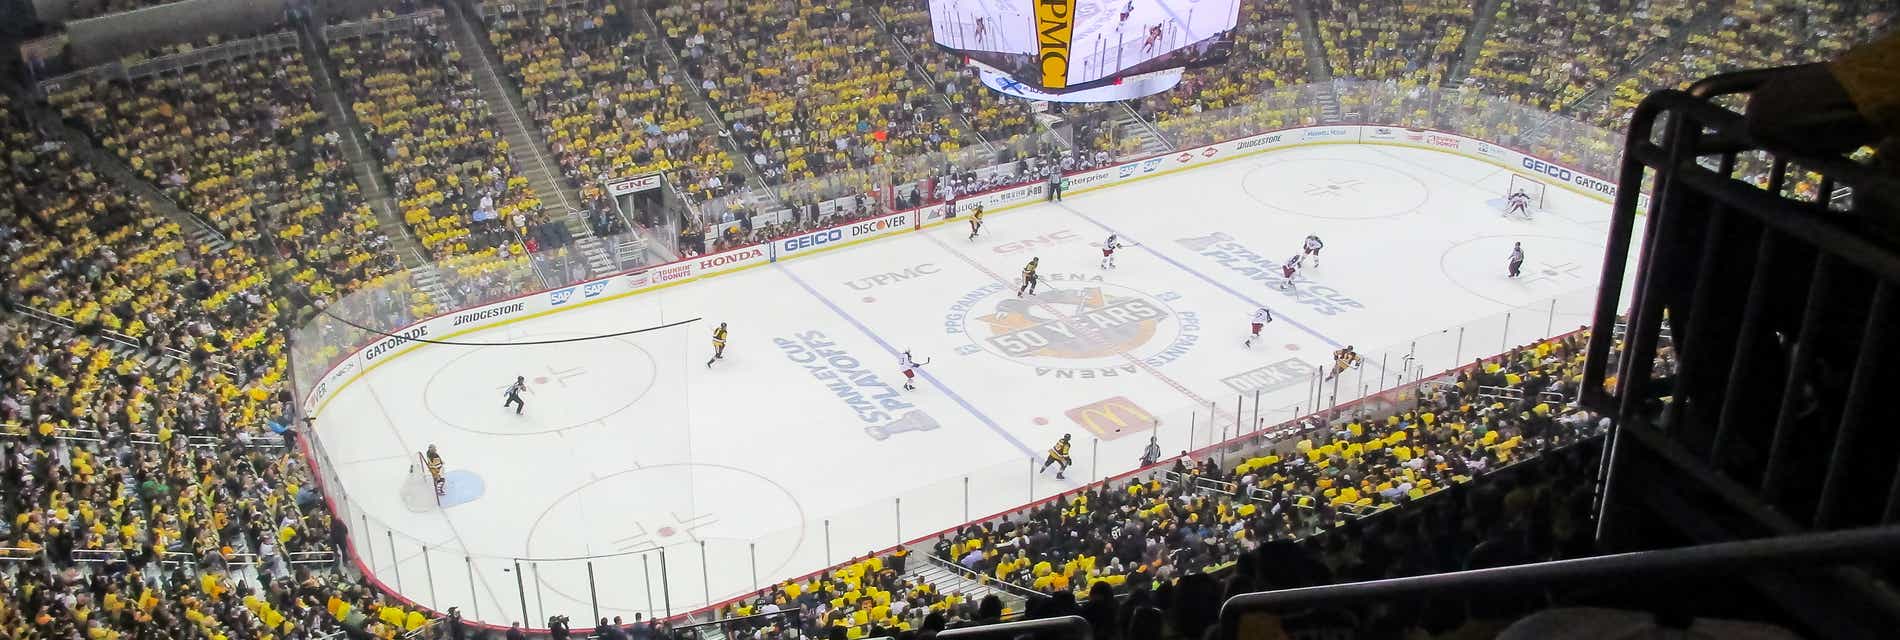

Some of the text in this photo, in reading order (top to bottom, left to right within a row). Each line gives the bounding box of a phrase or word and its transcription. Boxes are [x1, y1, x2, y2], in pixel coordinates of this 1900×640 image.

[1237, 135, 1281, 150] BRIDGESTONE
[1523, 157, 1571, 181] GEICO
[616, 178, 655, 191] GNC
[852, 216, 905, 236] DISCOVER
[784, 229, 842, 252] GEICO
[993, 230, 1081, 253] GNC
[699, 249, 763, 270] HONDA
[843, 263, 942, 290] UPMC
[453, 302, 525, 326] BRIDGESTONE
[366, 326, 428, 360] GATORADE
[993, 332, 1049, 354] 50
[773, 337, 893, 423] STANLEY CUP
[794, 330, 915, 411] PLAYOFFS
[1035, 365, 1137, 379] ARENA
